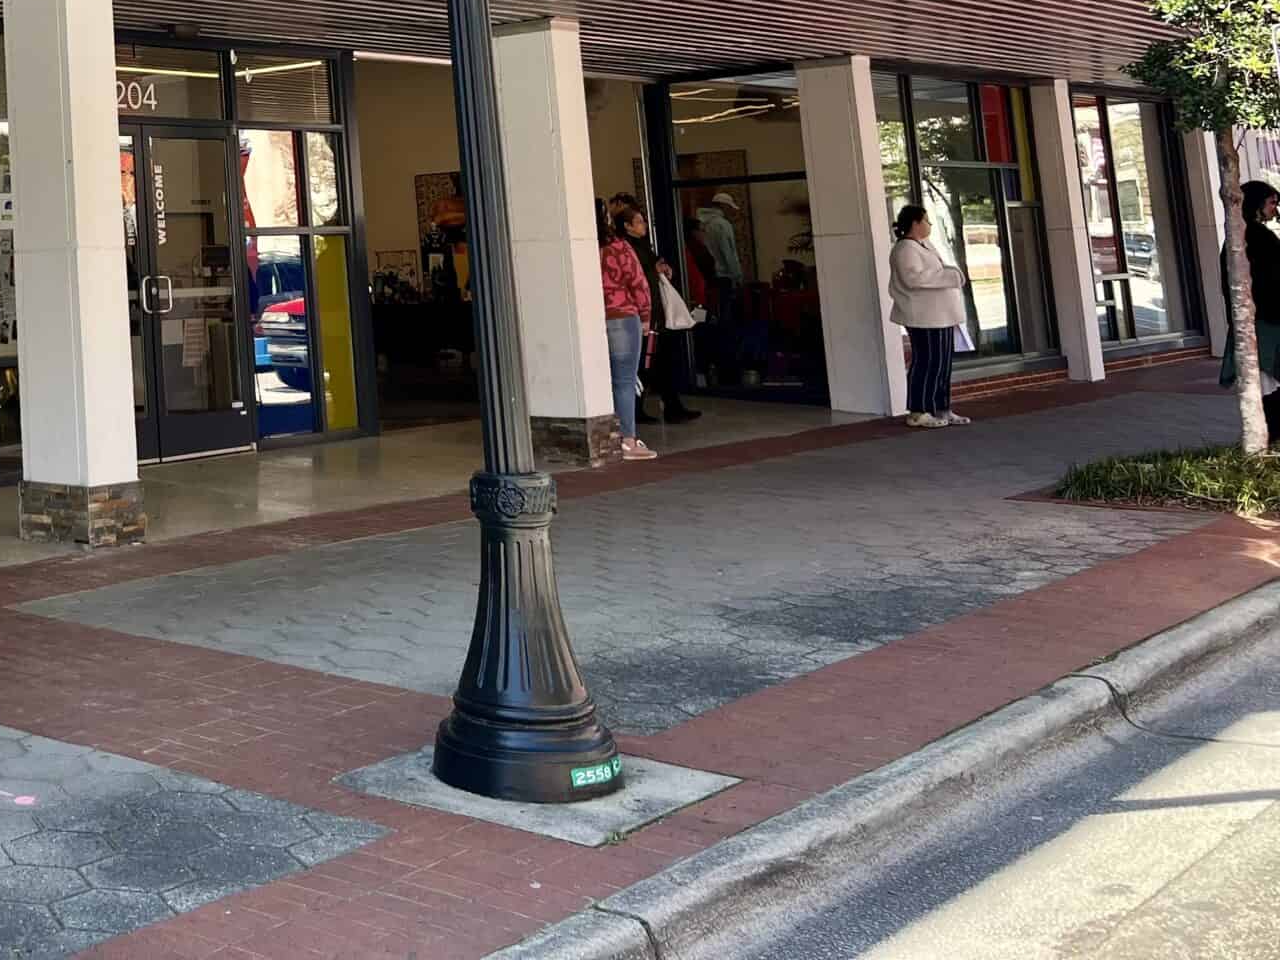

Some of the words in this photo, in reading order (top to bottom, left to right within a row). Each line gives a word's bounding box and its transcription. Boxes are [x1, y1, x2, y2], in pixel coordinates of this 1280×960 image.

[115, 81, 158, 111] 204
[153, 165, 167, 245] WELCOME
[575, 766, 612, 785] 2558
